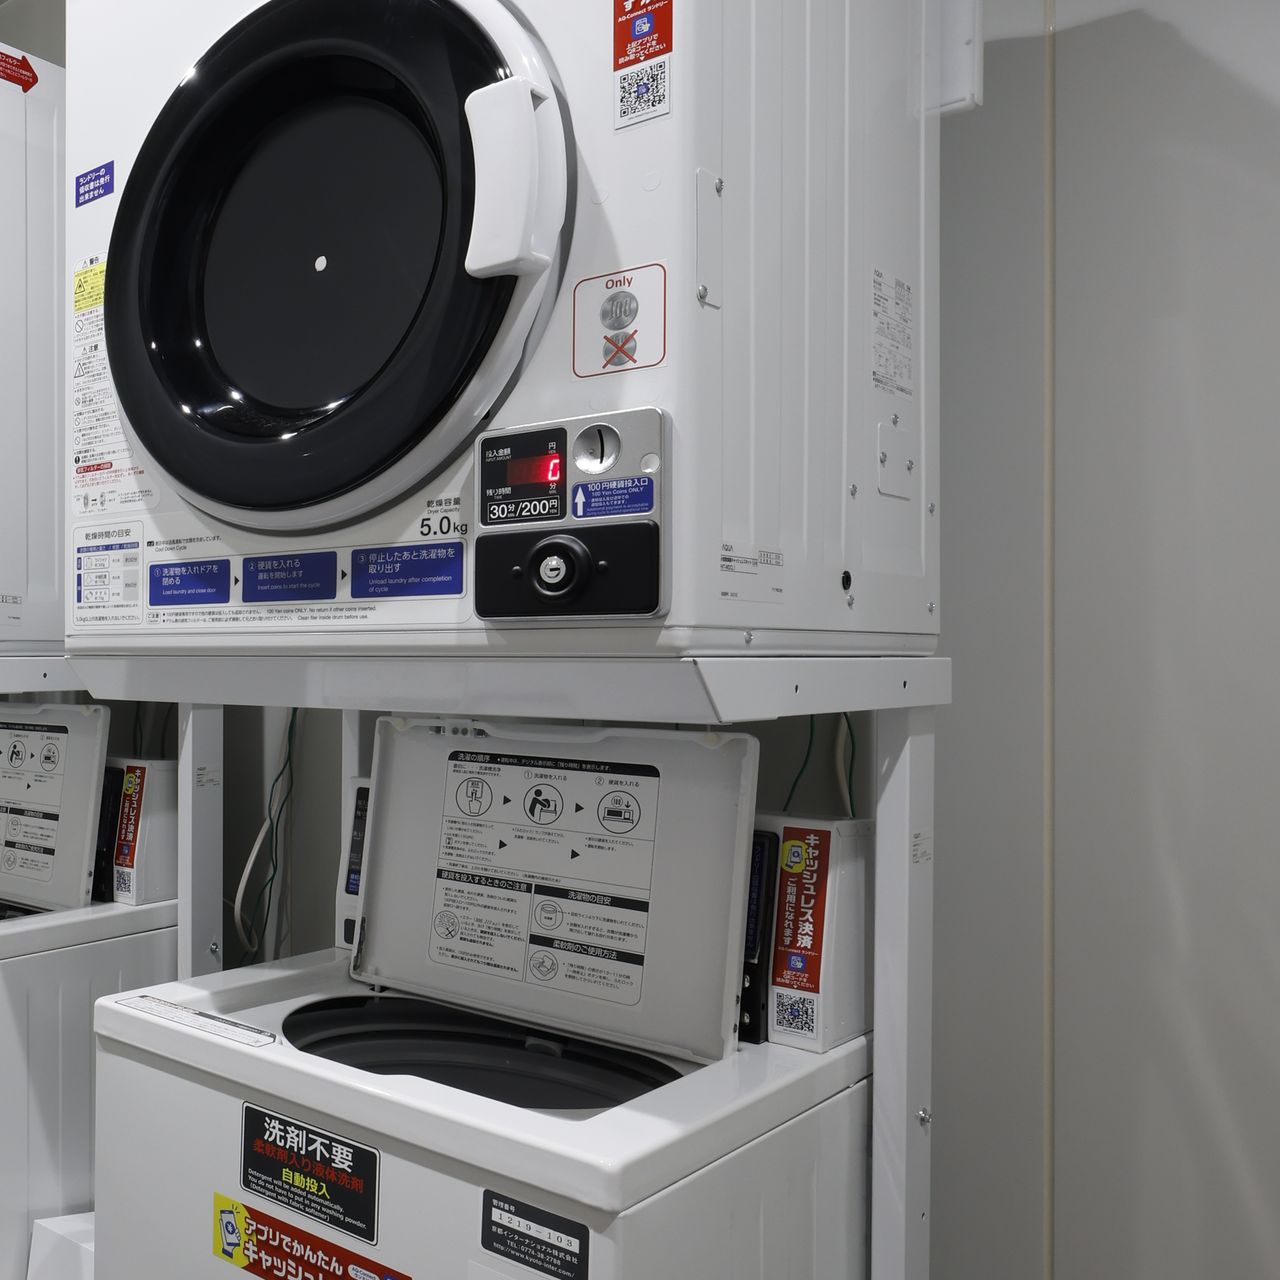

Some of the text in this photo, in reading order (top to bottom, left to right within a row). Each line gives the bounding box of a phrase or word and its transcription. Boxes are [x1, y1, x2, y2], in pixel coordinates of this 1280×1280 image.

[605, 276, 633, 290] Only
[548, 442, 556, 450] 円
[486, 487, 512, 496] 残り時間
[549, 482, 557, 490] 分
[588, 478, 649, 492] 100円硬貨投入口
[427, 497, 461, 508] 乾燥容量
[85, 529, 132, 541] 乾燥時間の目安
[369, 548, 455, 563] 停止したあと洗濯物を
[162, 565, 218, 577] 洗濯物を入れドアを
[258, 559, 300, 570] 硬貨を入れる
[368, 563, 401, 574] 取り出す
[162, 576, 180, 586] 閉める
[258, 570, 303, 580] 運転を開始します
[421, 575, 452, 584] completion
[441, 870, 527, 892] 硬貨を投入するときのご注意
[568, 890, 612, 905] 洗濯物の目安
[796, 834, 820, 949] キャッシュレス決済
[783, 877, 797, 946] ご利用になれます
[552, 940, 617, 960] 柔軟剤のご使用方法
[263, 1116, 354, 1173] 洗剤不要
[253, 1138, 364, 1194] 柔軟剤入り液体洗剤
[248, 1168, 345, 1213] Detergent will be added automatically.
[282, 1168, 330, 1200] 自動投入
[248, 1175, 258, 1184] You
[258, 1179, 265, 1187] do
[266, 1182, 274, 1191] not
[275, 1186, 287, 1195] have
[294, 1193, 303, 1203] put
[304, 1197, 310, 1205] in
[310, 1200, 321, 1210] any
[321, 1205, 344, 1221] washing
[345, 1215, 367, 1230] powder.
[277, 1193, 289, 1204] with
[289, 1198, 304, 1210] fabric
[305, 1205, 330, 1222] softener)
[492, 1199, 516, 1213] 管理番号
[245, 1217, 343, 1275] アプリでかんたん
[491, 1225, 579, 1265] 京都インターナショナル株式会社
[493, 1242, 575, 1278] http://www.kyoto-inter.com/
